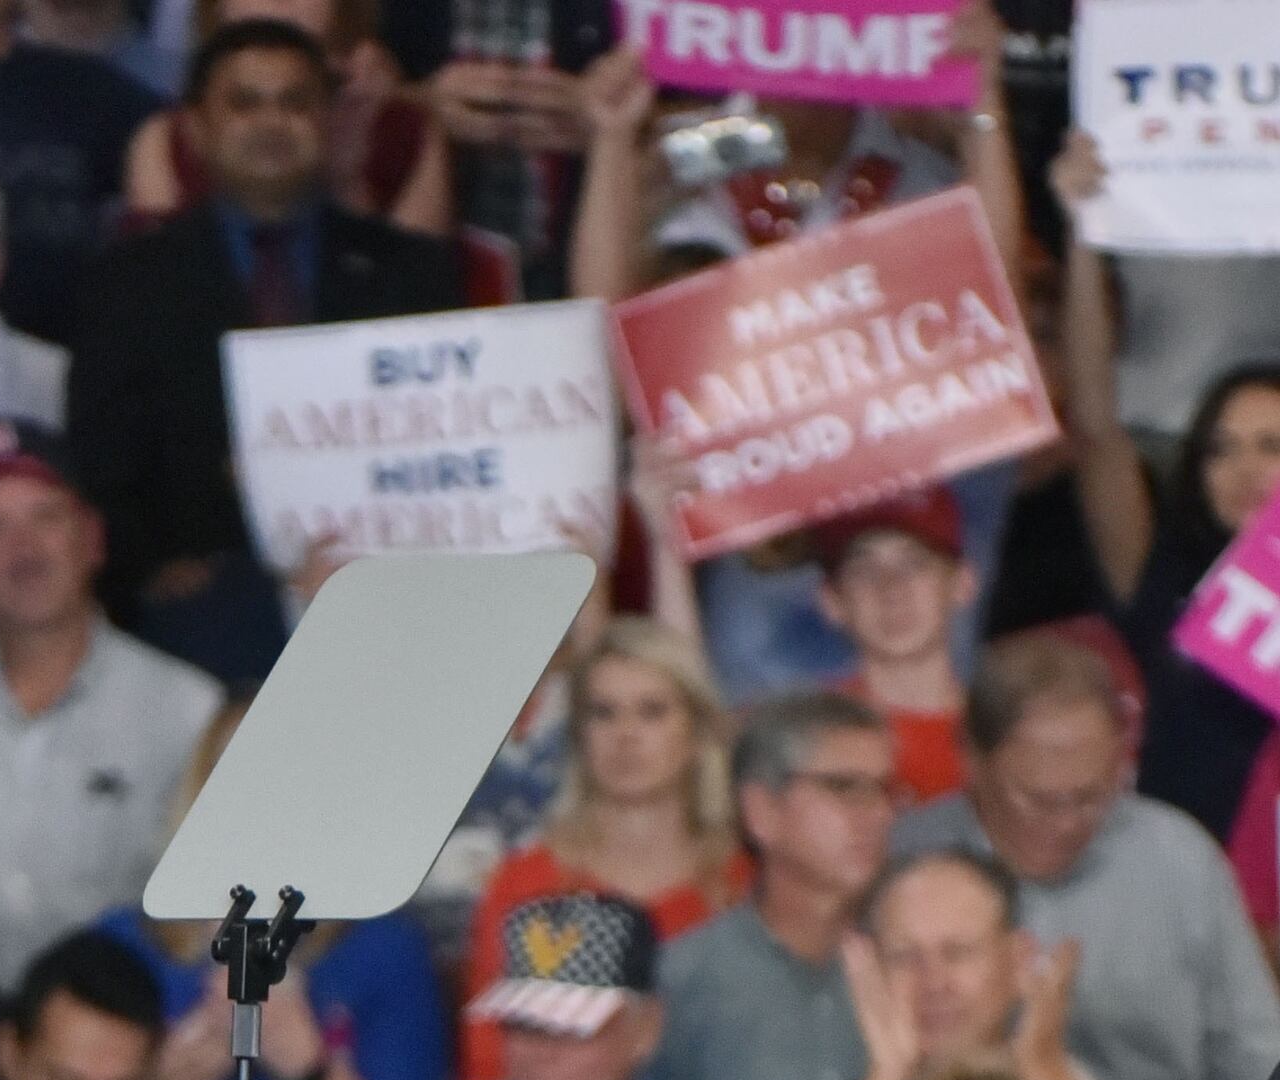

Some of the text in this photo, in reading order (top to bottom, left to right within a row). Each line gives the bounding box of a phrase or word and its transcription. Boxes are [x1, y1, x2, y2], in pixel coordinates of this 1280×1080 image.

[730, 264, 884, 346] MAKE
[368, 338, 484, 388] BUY
[658, 289, 1008, 448] AMERICA
[260, 376, 608, 450] AMERICAN
[692, 352, 1032, 494] ROUD AGAIN
[370, 448, 504, 494] HIRE
